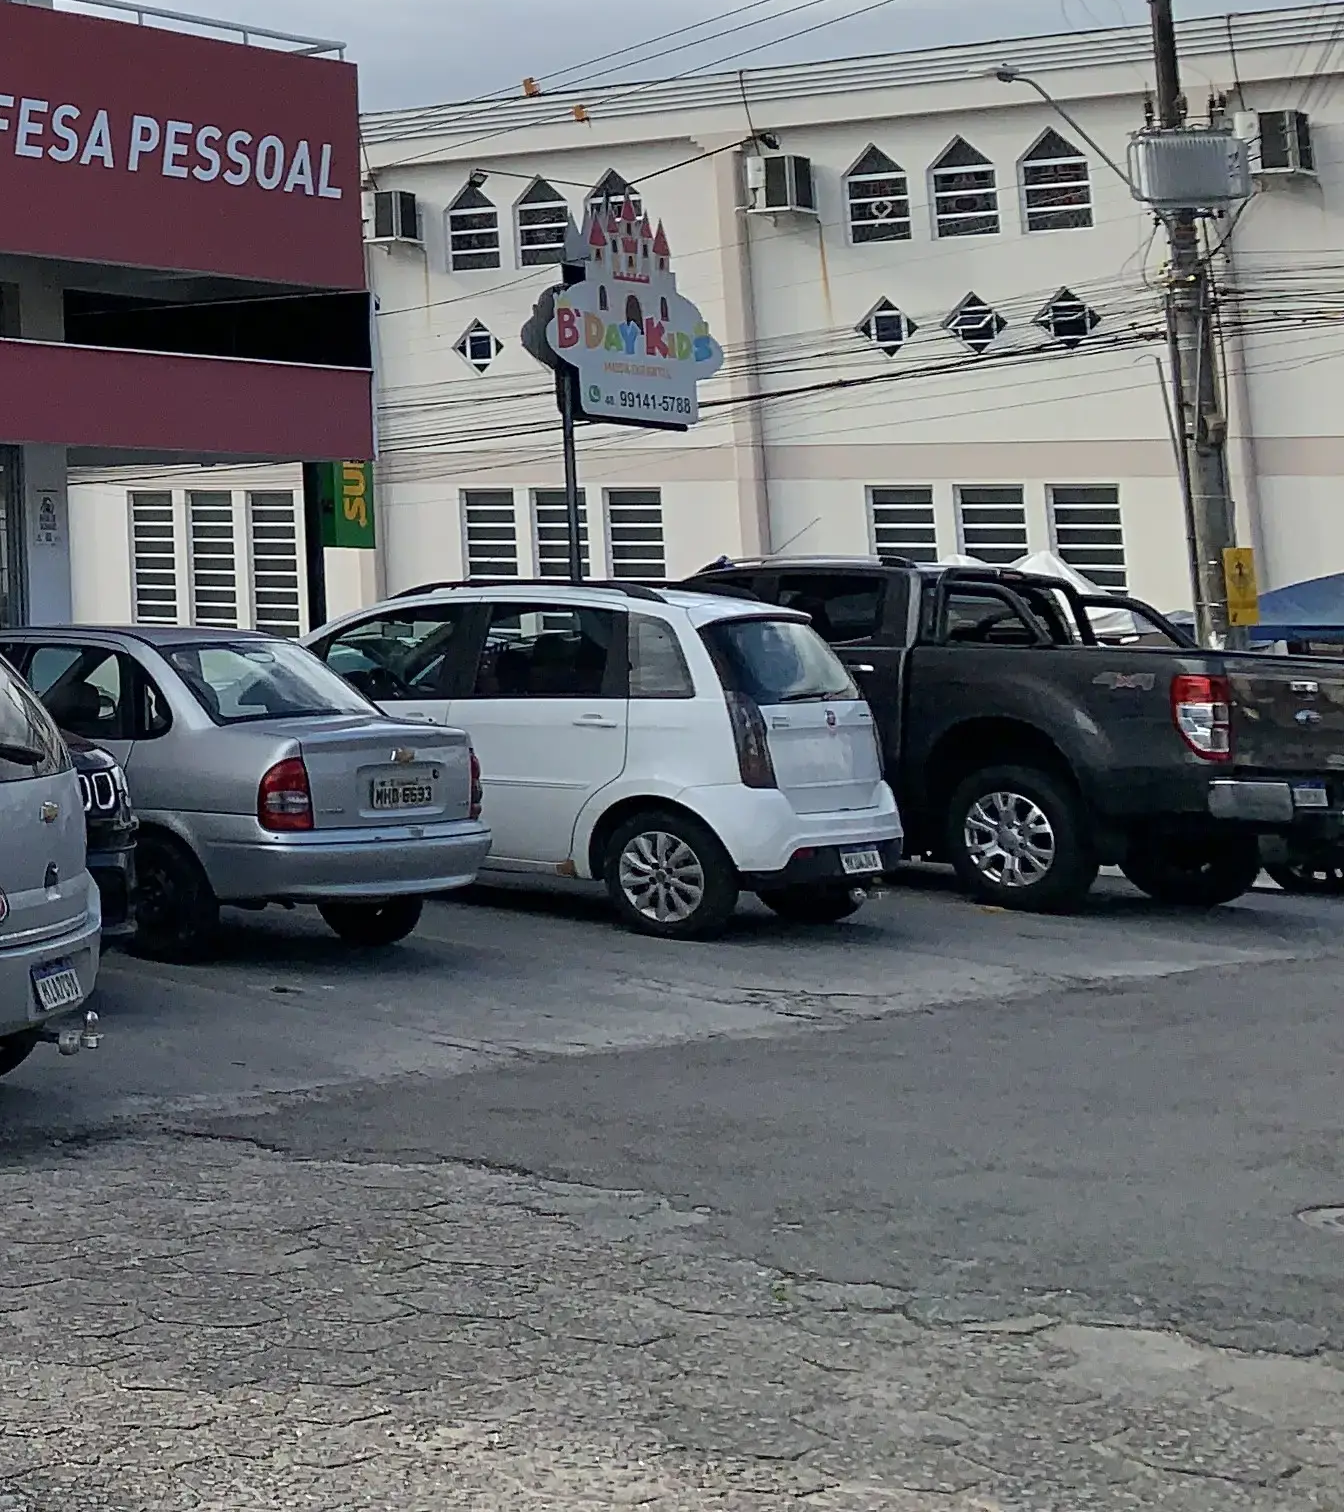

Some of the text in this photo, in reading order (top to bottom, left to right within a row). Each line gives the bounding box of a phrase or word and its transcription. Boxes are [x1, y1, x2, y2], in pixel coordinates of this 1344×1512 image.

[128, 113, 344, 200] PESSOAL
[619, 390, 692, 415] 99141-5788
[343, 461, 368, 528] SU
